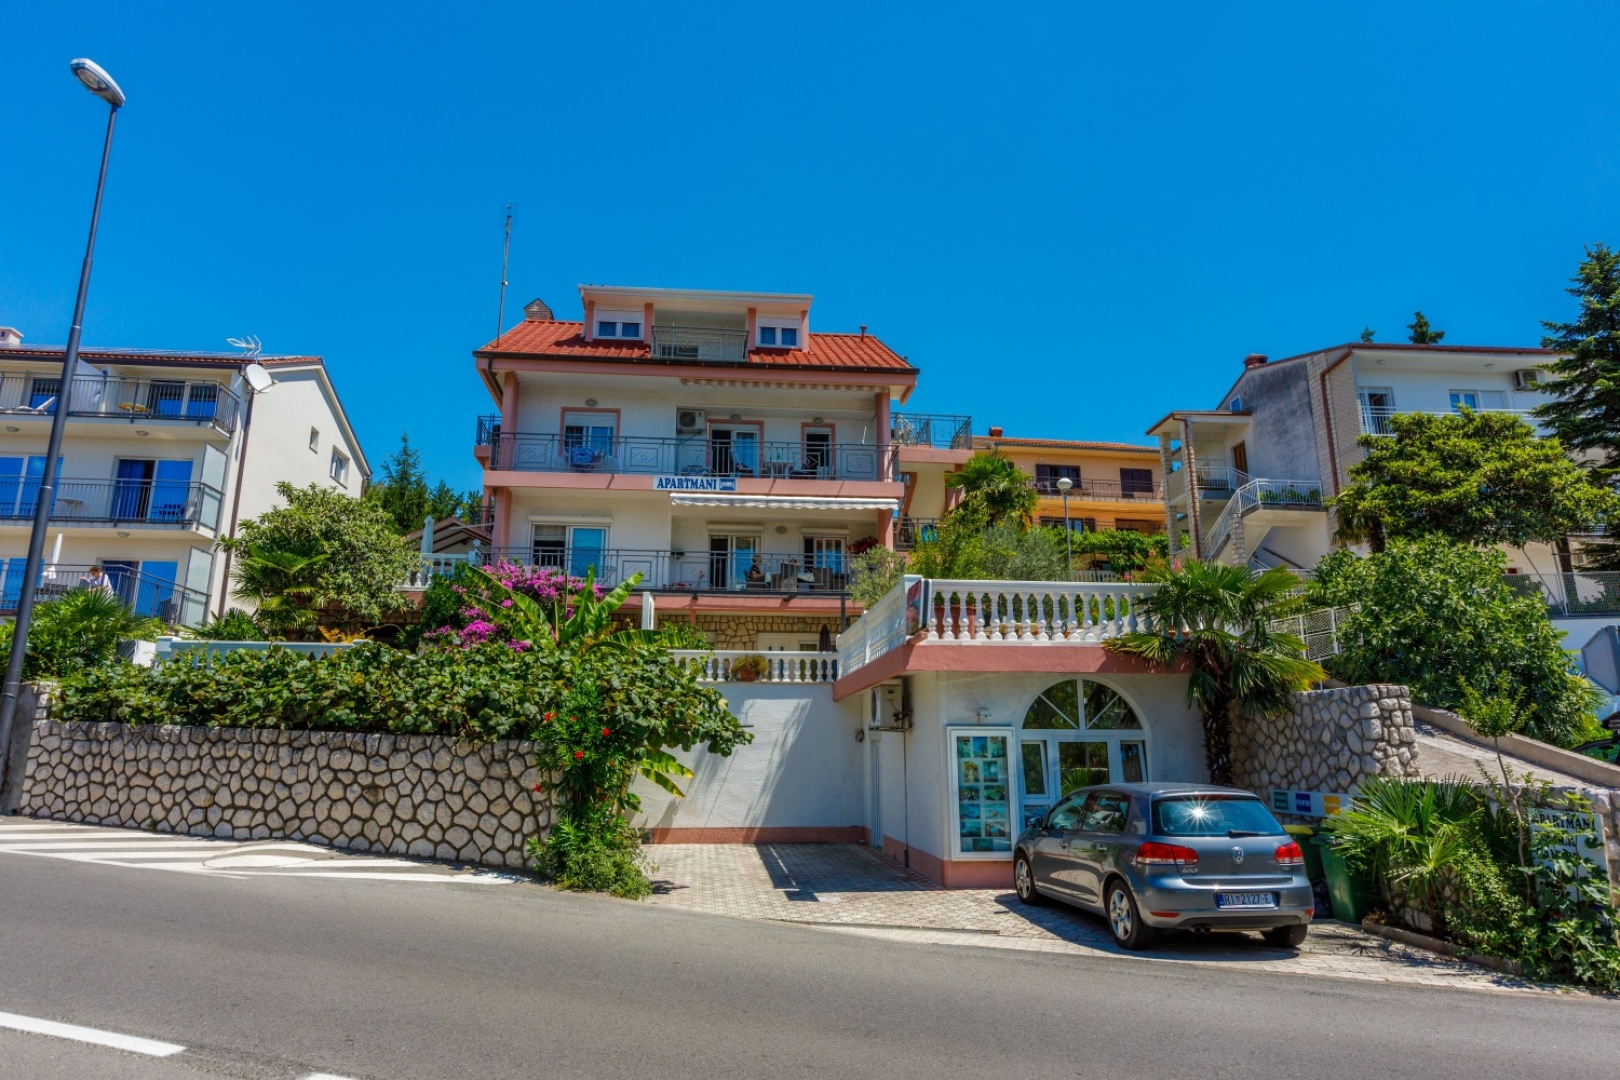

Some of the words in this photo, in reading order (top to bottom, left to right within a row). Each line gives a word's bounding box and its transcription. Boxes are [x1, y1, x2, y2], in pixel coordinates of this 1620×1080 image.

[656, 477, 717, 490] APARTMANI
[1224, 894, 1235, 905] RI
[1240, 893, 1271, 905] 2127-E
